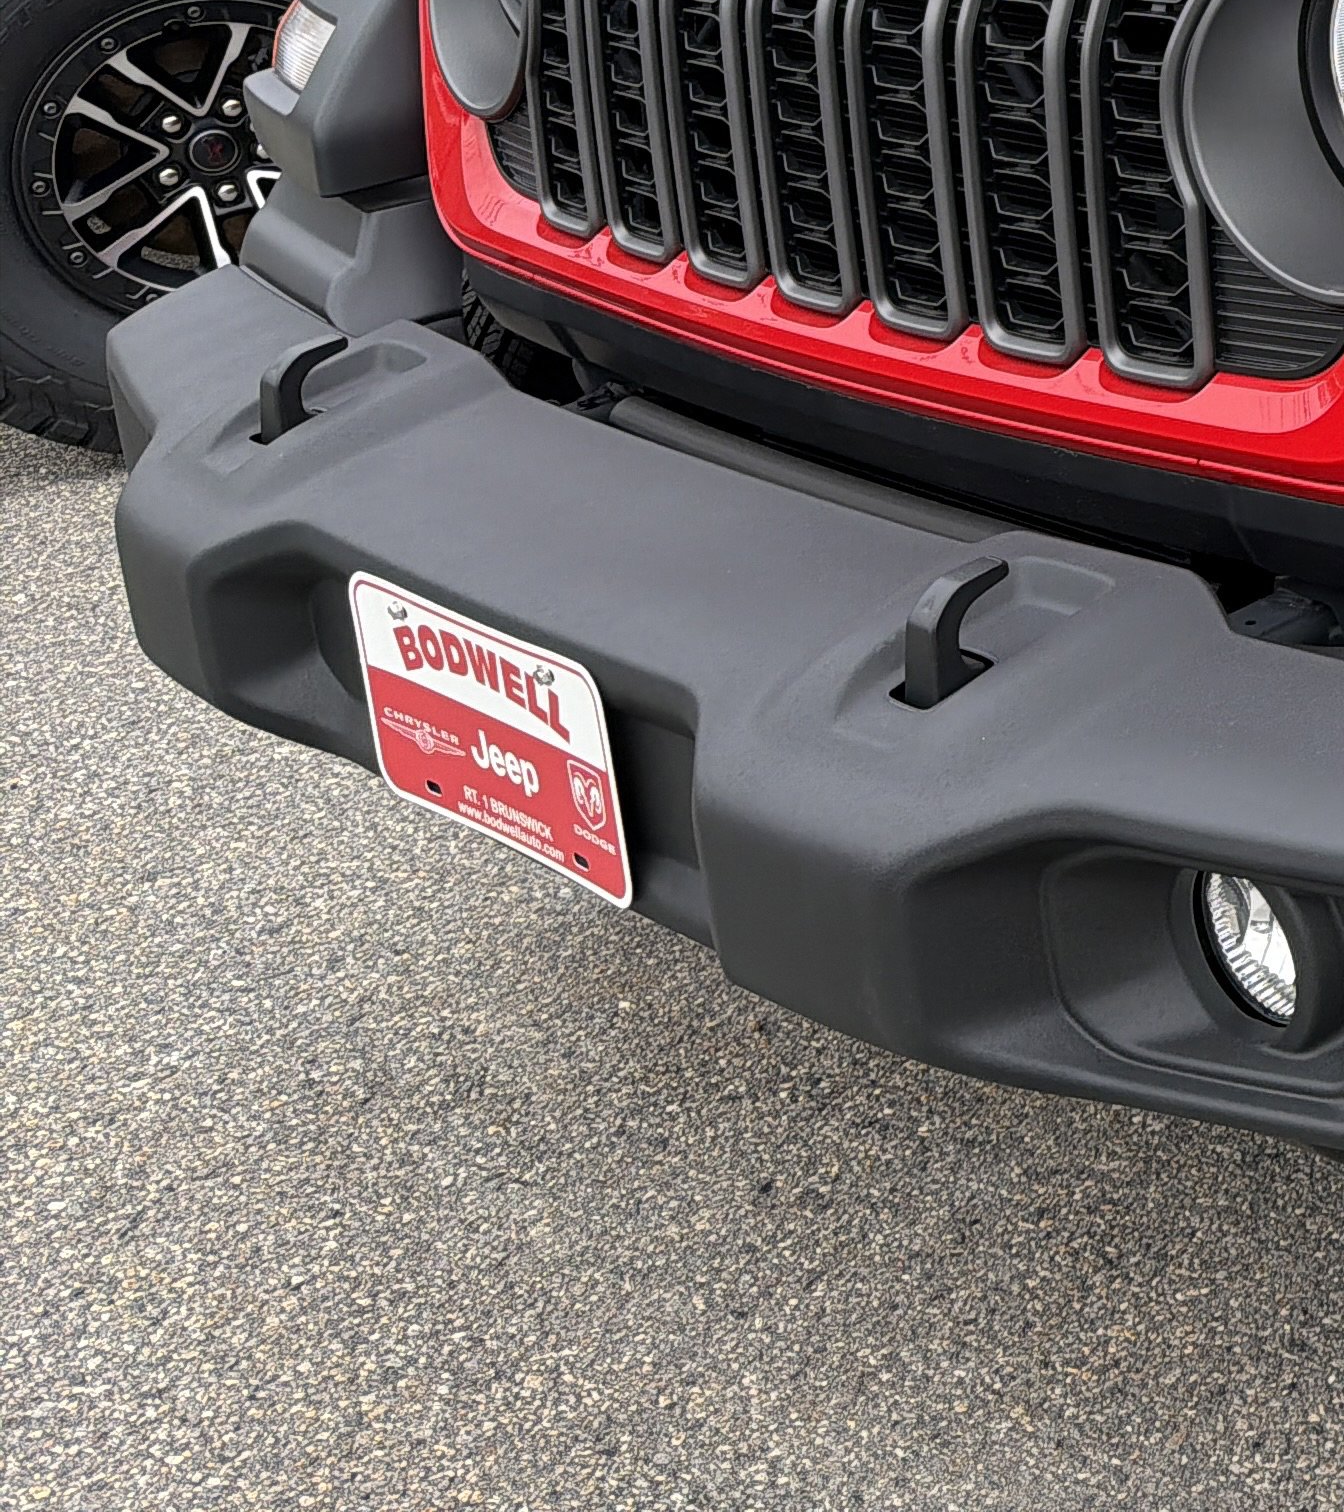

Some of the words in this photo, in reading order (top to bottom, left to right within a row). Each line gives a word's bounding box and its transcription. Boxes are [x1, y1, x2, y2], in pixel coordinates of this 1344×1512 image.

[392, 624, 571, 745] BODWELL
[383, 706, 461, 746] CHRYSLER
[470, 728, 540, 798] Jeep
[457, 800, 566, 864] www.bodwellauto.com
[462, 784, 481, 807] RT.
[482, 794, 489, 811] 1
[490, 796, 554, 843] BRUNSWICK
[572, 823, 618, 857] DODGE
